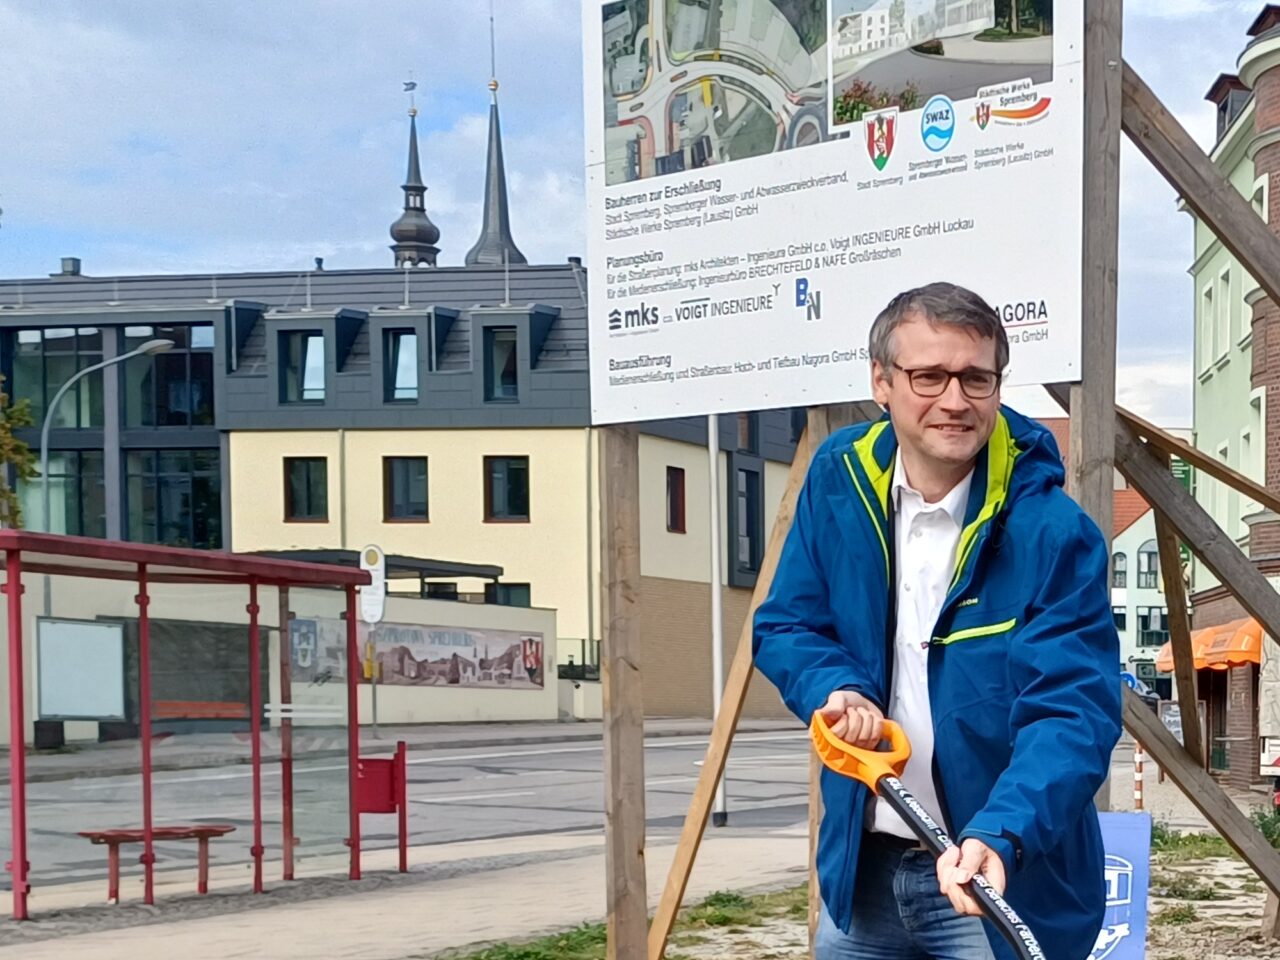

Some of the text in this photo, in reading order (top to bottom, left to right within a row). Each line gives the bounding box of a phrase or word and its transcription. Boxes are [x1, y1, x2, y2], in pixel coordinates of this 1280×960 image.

[1000, 92, 1037, 107] Spremberg
[925, 109, 950, 124] SWAZ
[1034, 148, 1053, 158] GmbH
[605, 179, 722, 210] Bauherren zur Erschließung
[740, 188, 755, 200] und
[735, 203, 759, 218] GmbH
[788, 242, 813, 257] GmbH
[830, 237, 850, 251] Voigt
[852, 225, 912, 247] INGENIEURE
[913, 220, 941, 238] GmbH
[606, 250, 664, 269] Planungsbüro
[748, 258, 813, 279] BRECHTEFELD
[814, 257, 820, 268] &
[822, 252, 847, 268] NAFE
[848, 247, 902, 265] Großräschen
[624, 302, 660, 329] mks
[675, 303, 710, 322] VOIGT
[710, 294, 773, 317] INGENIEURE
[1022, 328, 1049, 343] GmbH
[609, 355, 672, 371] Bauausführung
[676, 368, 689, 379] und
[757, 359, 772, 371] und
[801, 353, 830, 368] Nagora
[831, 349, 857, 363] GmbH
